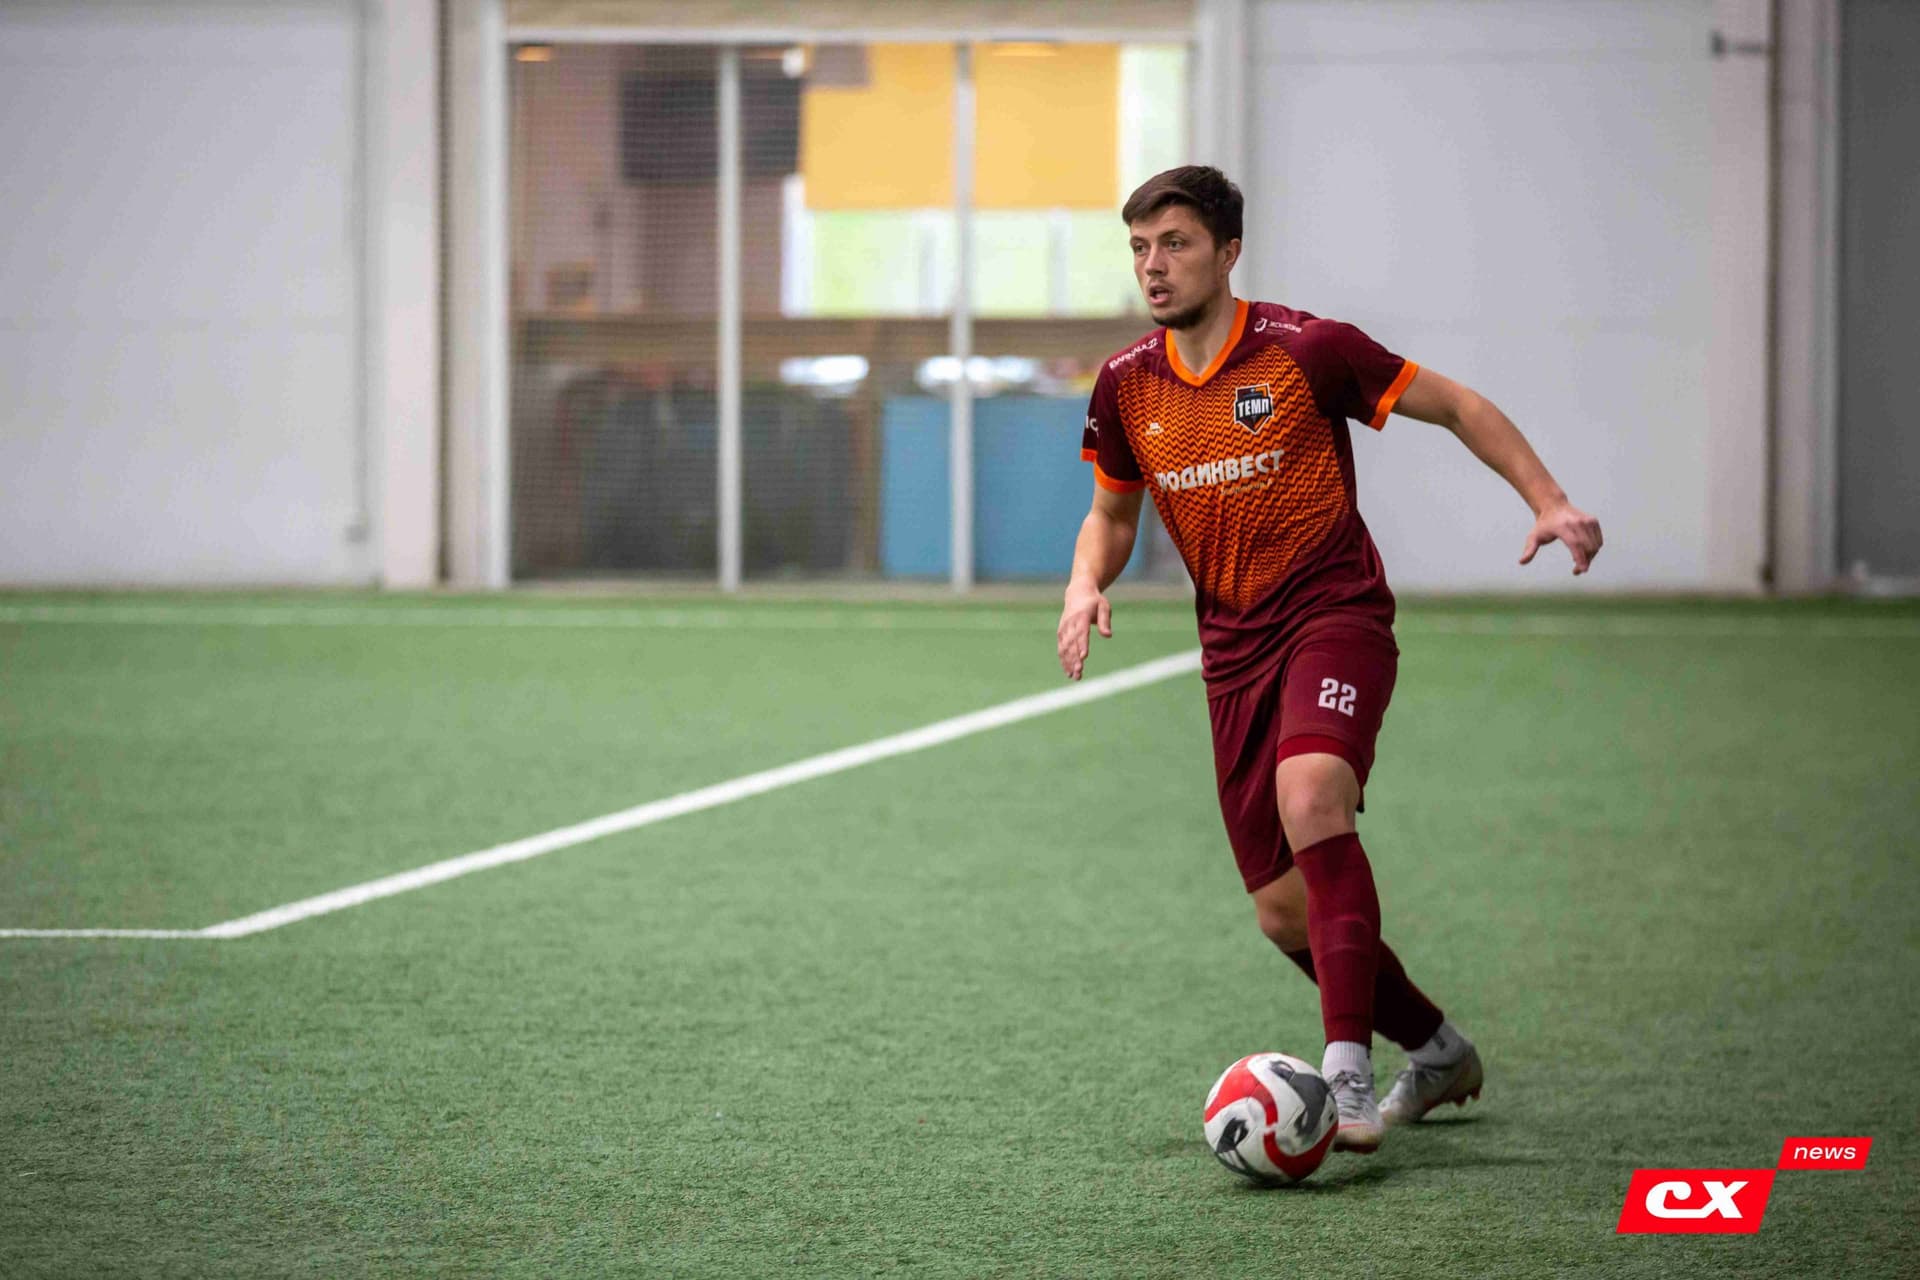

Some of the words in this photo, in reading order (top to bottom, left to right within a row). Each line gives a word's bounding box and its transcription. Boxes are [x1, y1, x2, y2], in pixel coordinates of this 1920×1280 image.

[1237, 398, 1270, 418] ТЕМП
[1155, 449, 1285, 492] РОДИНВЕСТ
[1318, 677, 1357, 717] 22
